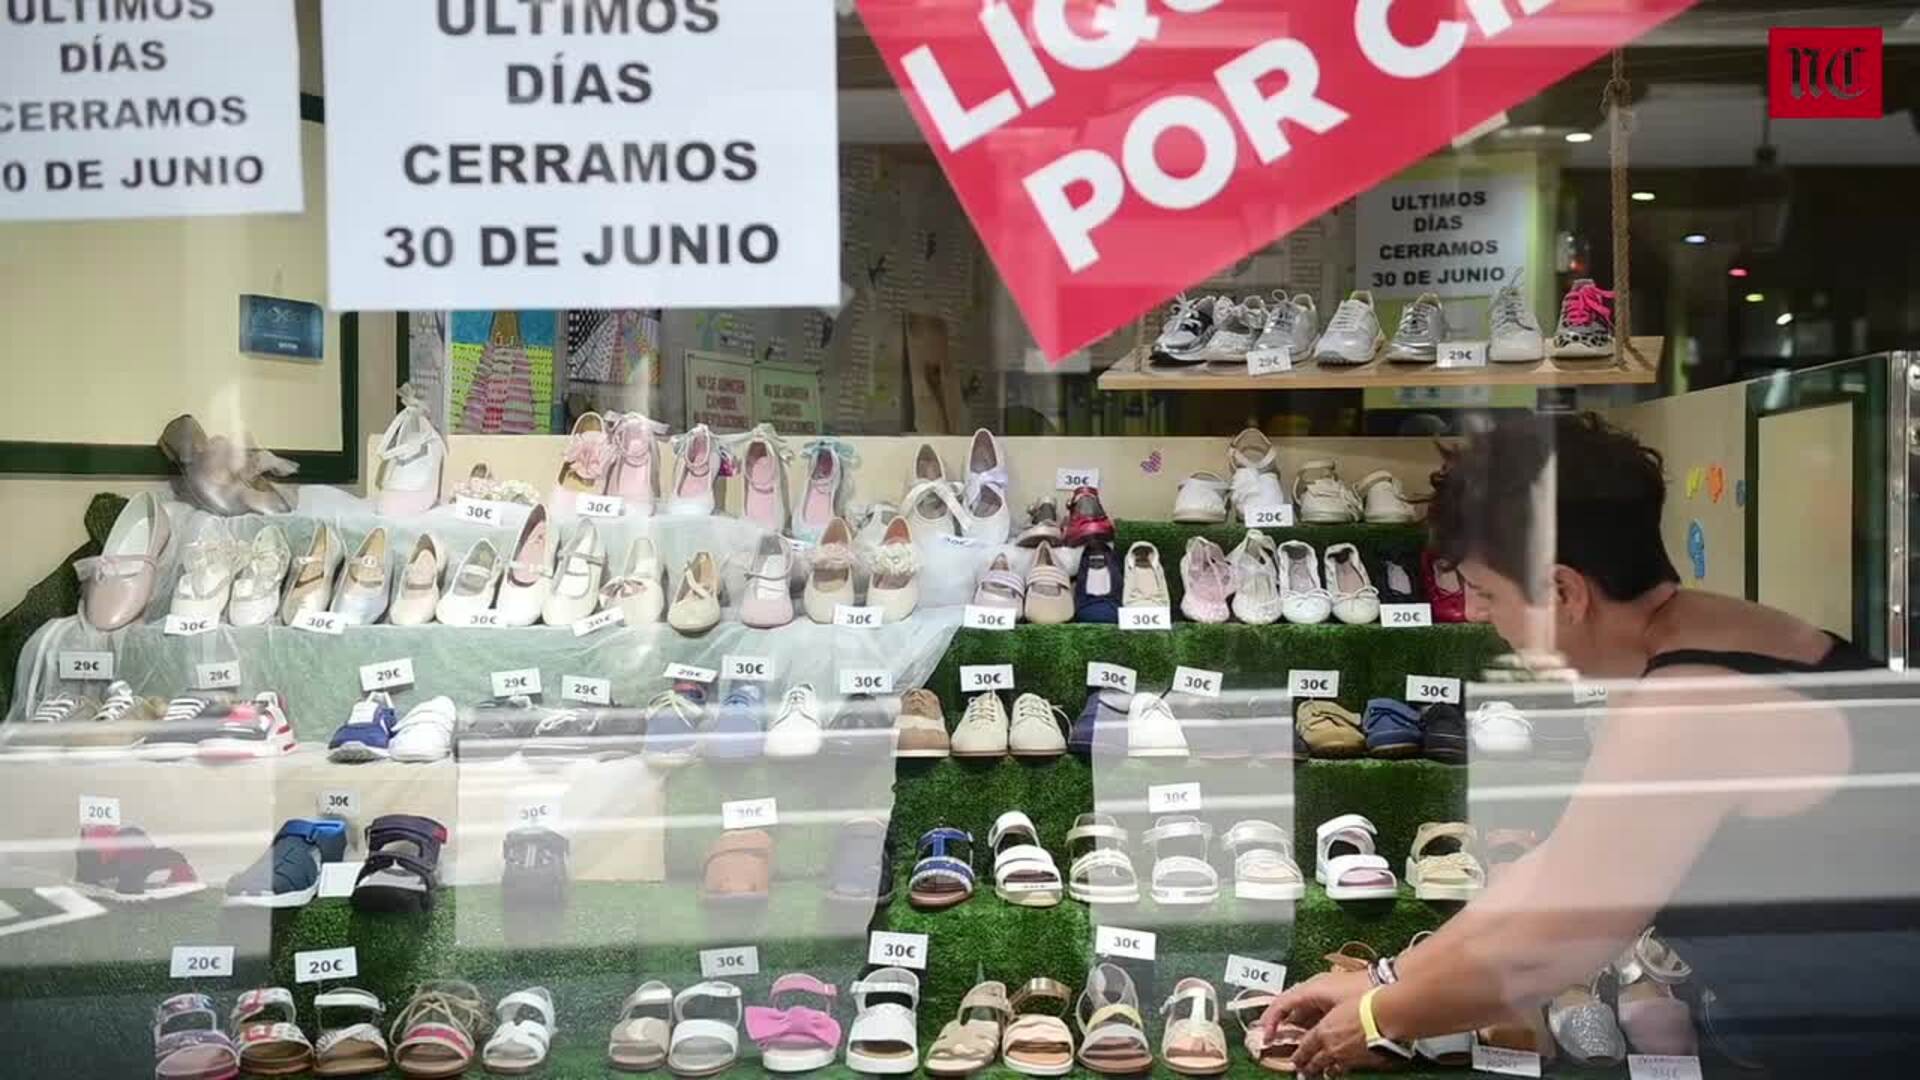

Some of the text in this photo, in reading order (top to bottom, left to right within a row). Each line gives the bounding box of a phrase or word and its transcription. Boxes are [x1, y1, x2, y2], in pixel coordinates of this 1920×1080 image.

[60, 35, 167, 73] DÍAS
[507, 52, 652, 104] DÍAS
[1021, 37, 1349, 273] POR
[403, 141, 758, 185] CERRAMOS
[45, 160, 104, 190] DE
[121, 156, 264, 188] JUNIO
[1392, 191, 1487, 211] ULTIMOS
[1414, 215, 1463, 232] DÍAS
[384, 223, 779, 268] 30 DE JUNIO
[1379, 240, 1498, 260] CERRAMOS
[1373, 267, 1505, 287] 30 DE JUNIO
[1449, 350, 1472, 360] 29€
[1065, 475, 1089, 485] 30€
[467, 505, 492, 519] 30€
[1257, 512, 1283, 522] 20€
[846, 614, 872, 624] 30€
[977, 614, 1006, 625] 30€
[1132, 614, 1160, 625] 30€
[1392, 612, 1420, 622] 20€
[74, 660, 99, 671] 29€
[736, 662, 764, 674] 30€
[208, 670, 231, 682] 29€
[377, 668, 400, 681] 29€
[975, 673, 1001, 684] 30€
[1102, 671, 1128, 686] 30€
[504, 677, 527, 688] 29€
[854, 676, 883, 688] 30€
[1185, 677, 1211, 690] 30€
[1300, 679, 1329, 691] 30€
[573, 684, 598, 696] 29€
[1420, 685, 1449, 697] 30€
[89, 806, 113, 818] 20€
[1114, 936, 1140, 949] 30€
[884, 944, 916, 958] 30€
[188, 957, 221, 969] 20€
[309, 959, 343, 973] 20€
[717, 956, 744, 967] 30€
[1241, 967, 1270, 982] 30€
